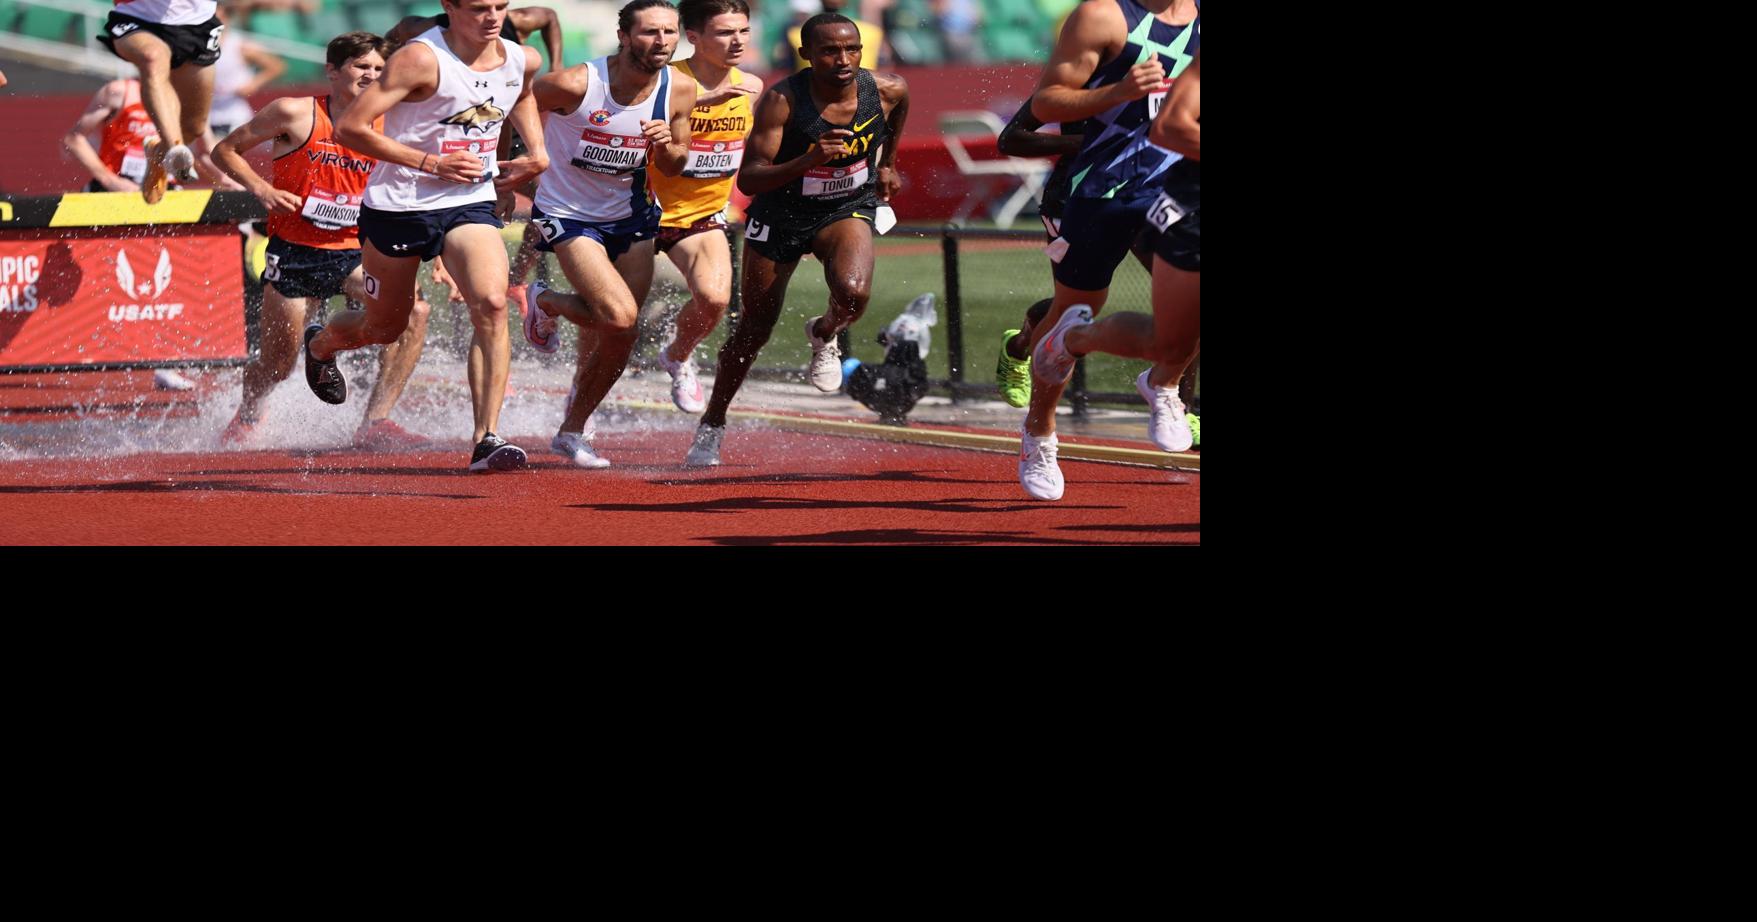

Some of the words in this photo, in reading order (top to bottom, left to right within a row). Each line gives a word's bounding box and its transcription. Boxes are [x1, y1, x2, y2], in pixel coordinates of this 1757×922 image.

[306, 149, 375, 174] VIRGINI
[582, 145, 639, 165] GOODMAN
[695, 154, 733, 168] BASTEN
[822, 176, 854, 193] TONUI
[311, 202, 360, 222] JOHNSON
[0, 255, 40, 284] PIC
[108, 303, 184, 321] USATF
